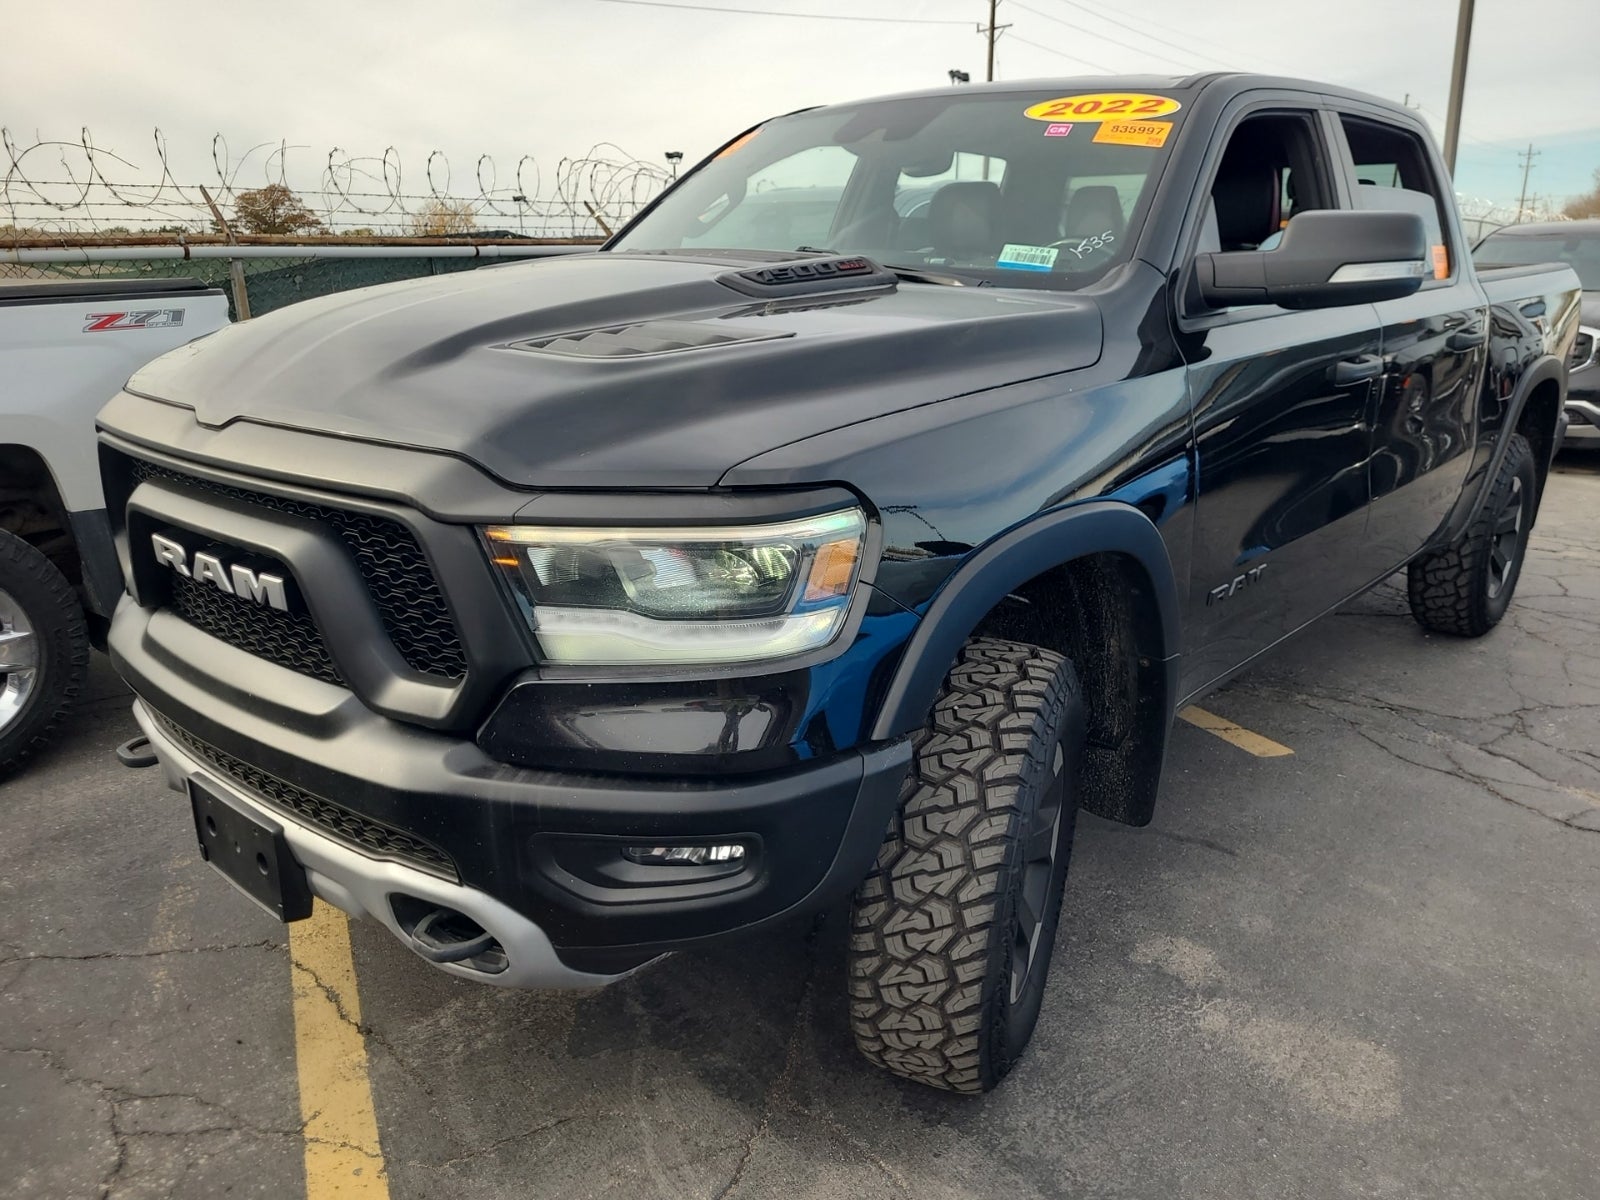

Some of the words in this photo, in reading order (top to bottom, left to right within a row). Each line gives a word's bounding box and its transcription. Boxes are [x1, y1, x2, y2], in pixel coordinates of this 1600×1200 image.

[1040, 99, 1166, 117] 2022
[1111, 124, 1165, 136] 835997
[756, 262, 837, 282] 1500
[82, 308, 185, 333] Z71
[152, 533, 289, 612] RAM
